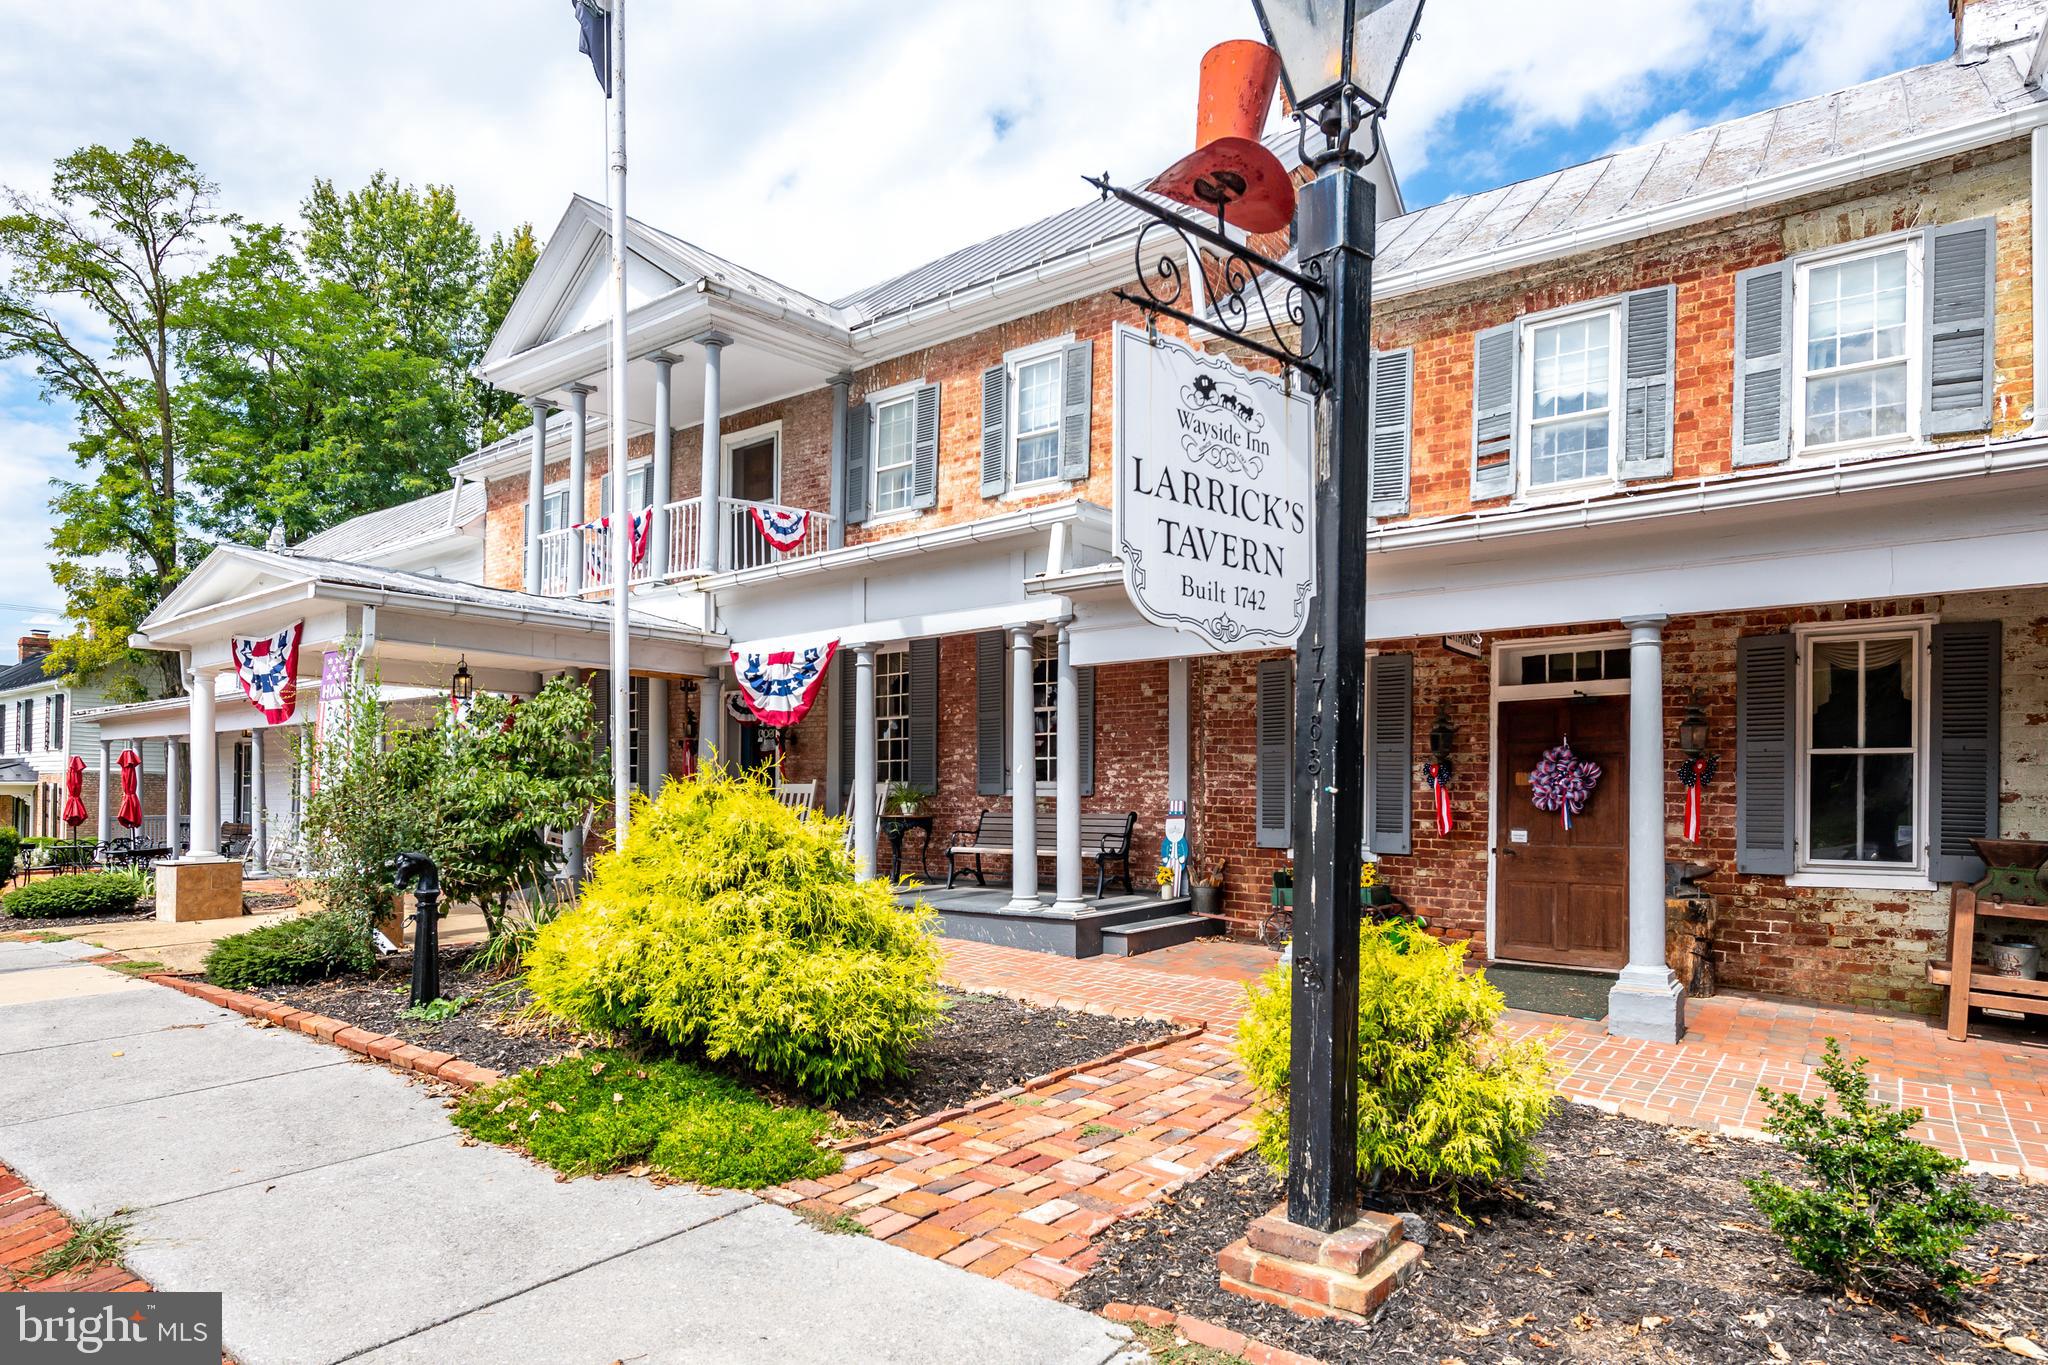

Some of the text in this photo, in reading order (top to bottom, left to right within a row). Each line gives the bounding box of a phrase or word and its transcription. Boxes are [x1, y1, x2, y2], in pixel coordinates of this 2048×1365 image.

[1176, 408, 1270, 456] Wayside Inn
[1132, 456, 1305, 534] LARRICK'S
[1157, 518, 1285, 578] TAVERN
[1181, 574, 1267, 611] Built 1742
